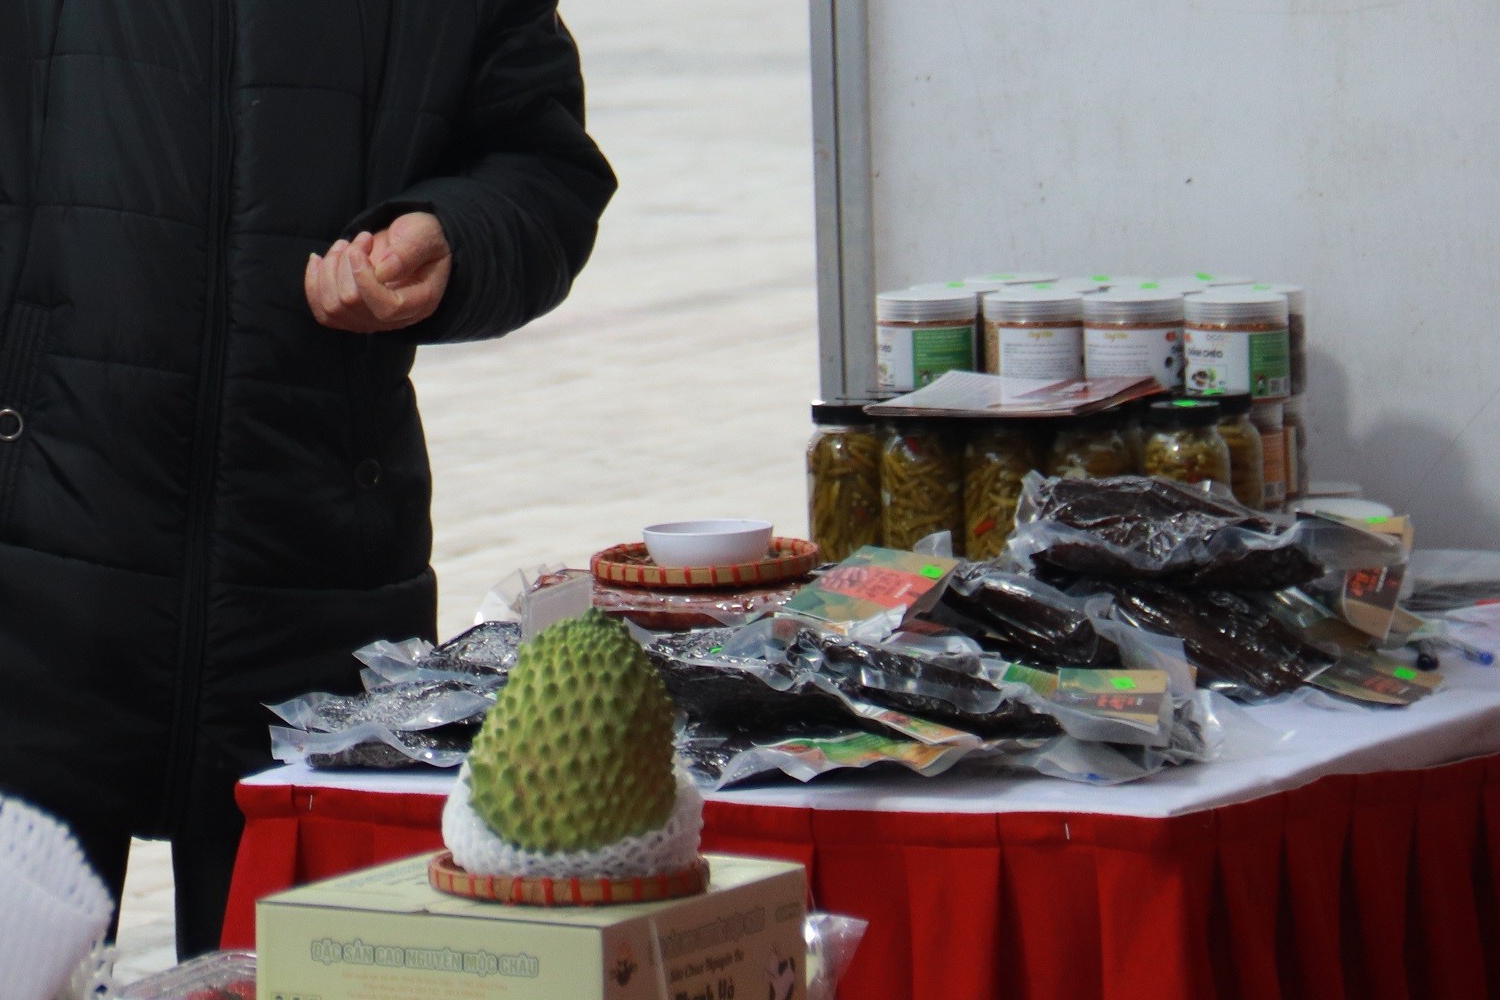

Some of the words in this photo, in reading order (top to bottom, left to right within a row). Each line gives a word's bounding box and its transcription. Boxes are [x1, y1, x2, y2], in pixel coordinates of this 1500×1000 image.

[374, 944, 405, 969] CAO
[404, 946, 464, 973] NGUYÊN
[463, 950, 500, 978] MỘC
[499, 952, 540, 978] CHÂU
